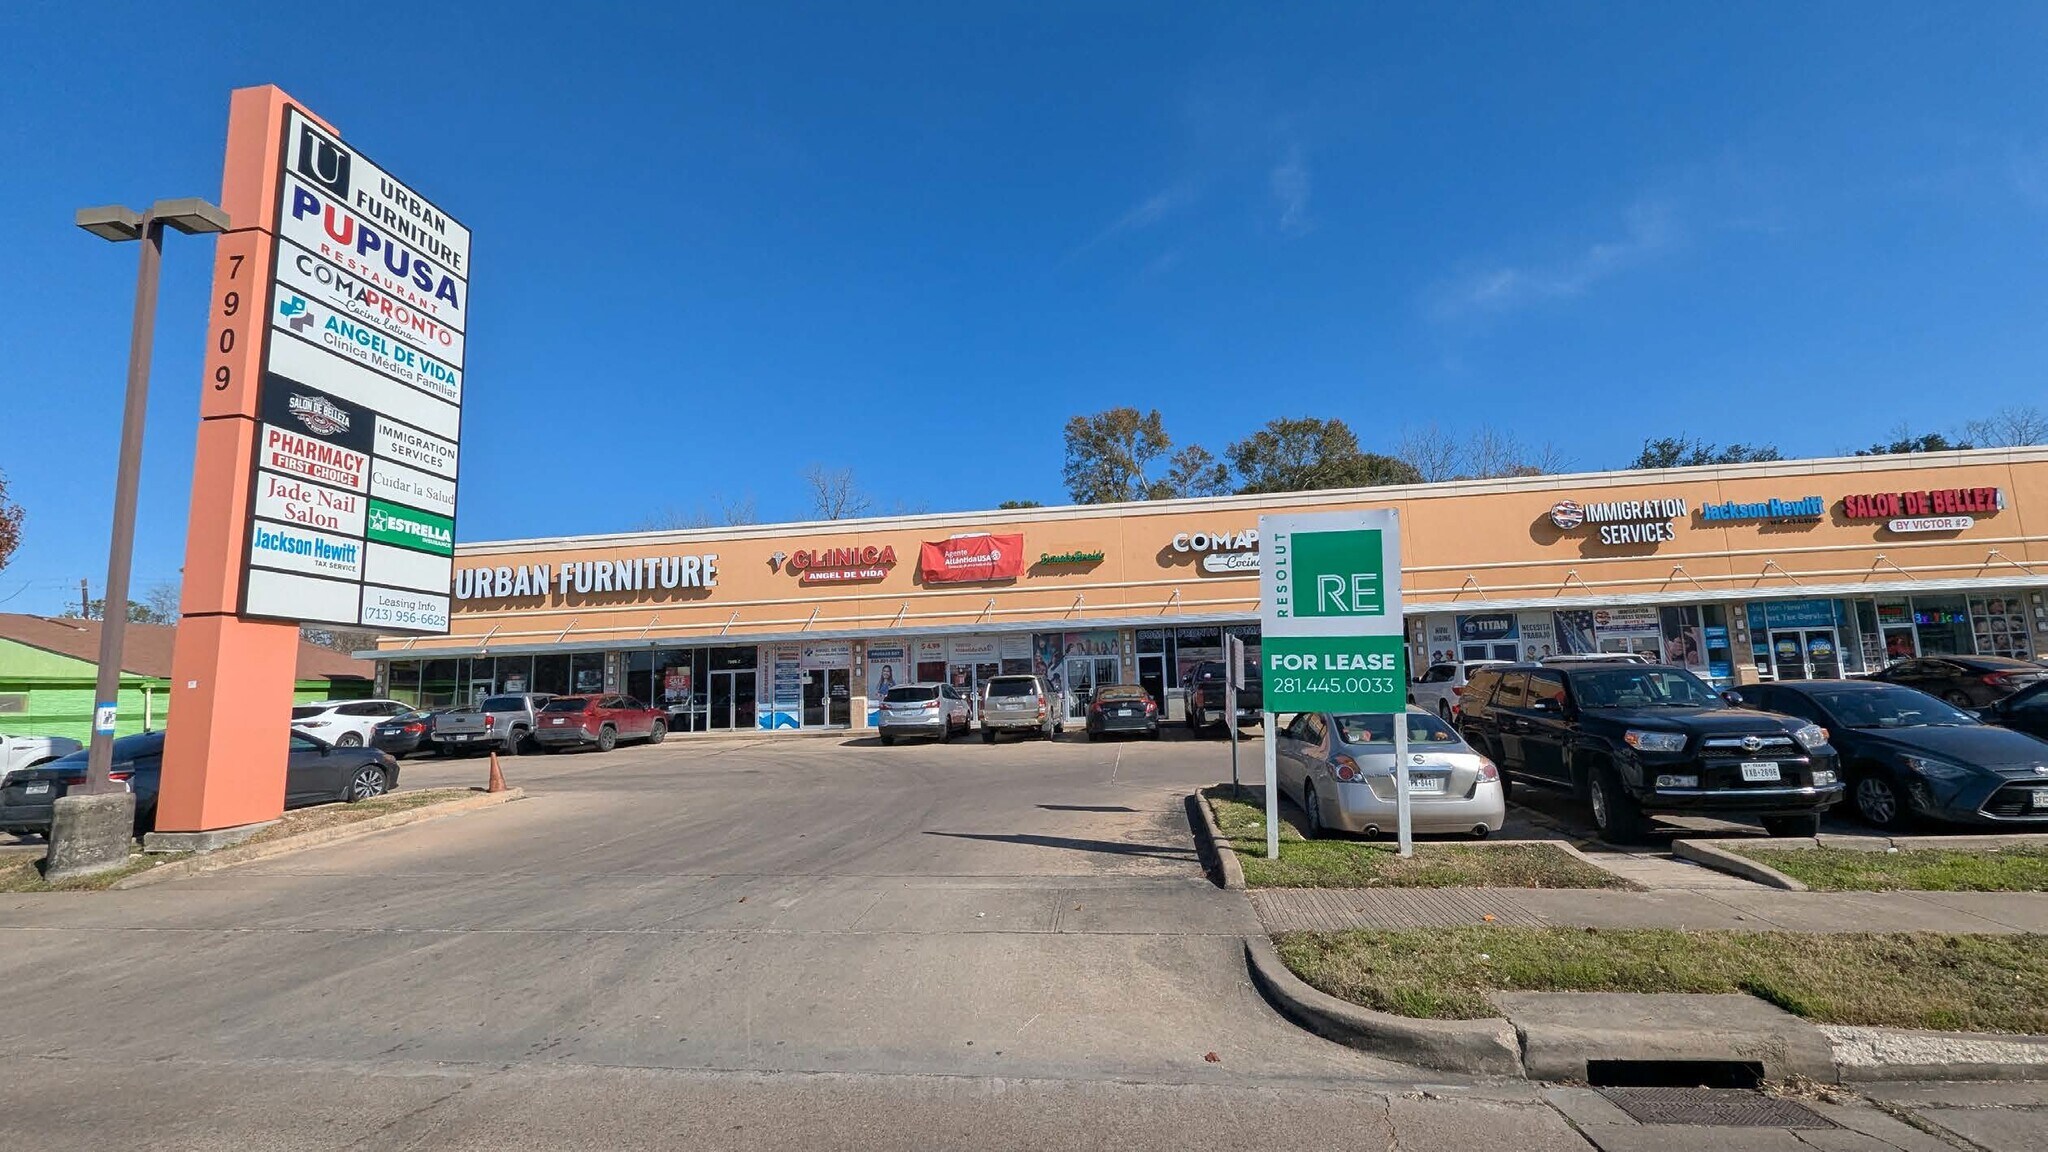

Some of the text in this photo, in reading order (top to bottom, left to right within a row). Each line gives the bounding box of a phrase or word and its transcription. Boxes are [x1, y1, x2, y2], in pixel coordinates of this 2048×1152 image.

[380, 177, 445, 236] URBAN
[356, 188, 462, 270] FURNITURE
[292, 184, 459, 310] PUPUSA
[321, 243, 438, 314] RESTAURANT
[345, 301, 381, 326] Cocina
[325, 315, 456, 387] ANGEL DE VIDA
[323, 332, 457, 399] Clínica Médica Familiar
[289, 397, 350, 428] SALON DE BELLEZA
[268, 430, 364, 474] PHARMACY
[378, 424, 456, 460] IMMIGRATION
[391, 443, 443, 468] SERVICES
[276, 456, 356, 486] FIRST CHOICE
[268, 477, 356, 514] Jade Nail
[373, 472, 455, 506] Cuidar la Salud
[1584, 499, 1687, 522] IMMIGRATION
[1702, 496, 1824, 520] Jackson Hewitt
[1843, 487, 2006, 518] SALON DE BELLEZA
[285, 503, 339, 529] Salon
[387, 516, 452, 542] ESTRELLA
[1896, 518, 1968, 530] BY VICTOR #2
[254, 528, 356, 564] Jackson Hewitt
[1601, 522, 1675, 544] SERVICES
[315, 560, 357, 572] TAX SERVICE
[791, 545, 898, 569] CLINICA
[944, 549, 968, 560] Agente
[455, 554, 719, 600] URBAN FURNITURE
[1274, 534, 1288, 618] RESOLUT
[379, 595, 437, 612] Leasing Info
[1317, 573, 1380, 613] RE
[364, 606, 446, 627] (713) 956-6625
[1477, 621, 1508, 630] TITAN
[1522, 624, 1550, 632] NECESITA
[1523, 632, 1550, 640] TRABAJO
[1271, 654, 1396, 670] FOR LEASE
[1274, 678, 1394, 694] 281.445.0033
